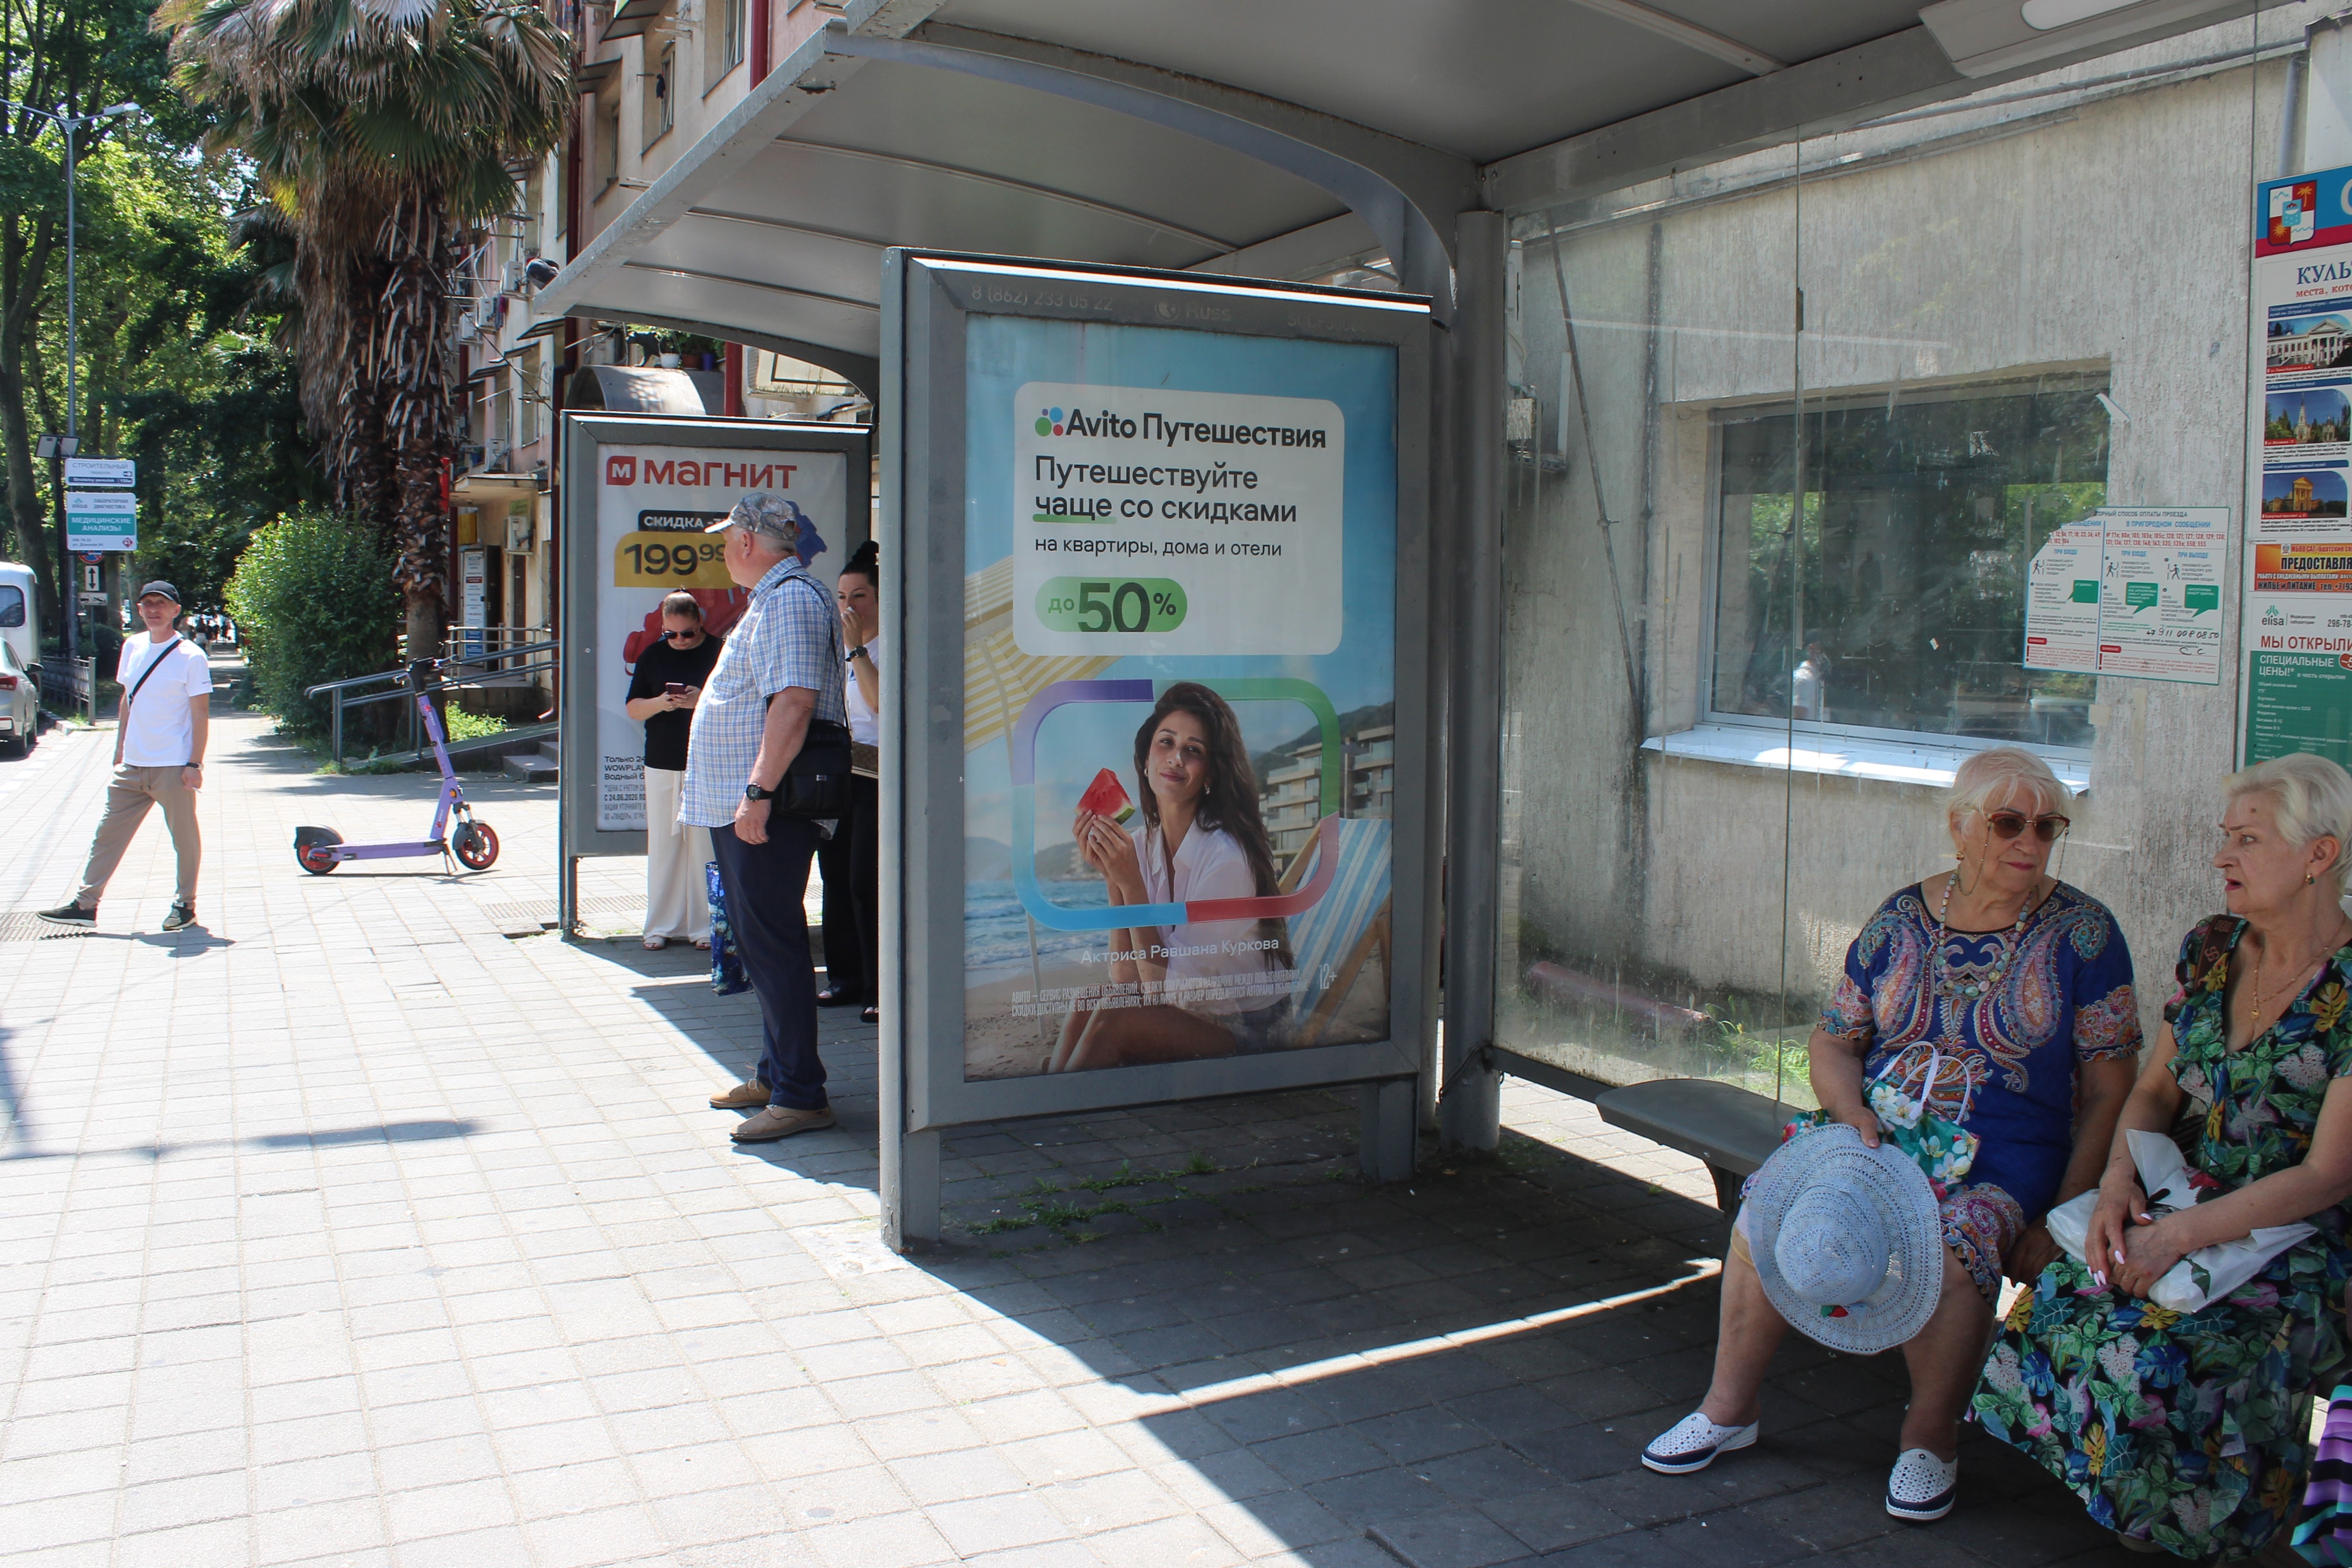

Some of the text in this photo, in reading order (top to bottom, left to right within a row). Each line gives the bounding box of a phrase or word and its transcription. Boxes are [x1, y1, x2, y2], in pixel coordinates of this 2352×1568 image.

[2297, 261, 2352, 285] КУЛЬ
[988, 285, 1028, 306] (862)
[1034, 291, 1063, 307] 233
[2296, 287, 2328, 298] места,
[1066, 409, 1326, 448] Avito Путешествия
[1035, 455, 1258, 494] Путешествуйте
[1035, 496, 1297, 525] чаще со скидками
[644, 516, 705, 530] СКИДКА
[1035, 537, 1282, 557] на квартиры, дома и отели
[2281, 557, 2352, 572] ПРЕДОСТАВЛЯ
[2258, 581, 2280, 590] ЖИЛЬЕ
[2287, 582, 2316, 590] ПИТАНИЕ
[1048, 598, 1074, 614] до
[2262, 615, 2284, 626] elisa
[2261, 635, 2283, 648] МЫ
[2260, 655, 2334, 667] СПЕЦИАЛЬНЫЕ
[1080, 939, 1279, 965] Актриса Равшана Куркова
[1318, 963, 1337, 990] 12+
[1011, 990, 1031, 1004] АВИТО
[1040, 988, 1061, 1002] СЕРВИС
[1062, 985, 1100, 1001] РАЗМЕЩЕНИЯ
[1101, 981, 1139, 997] ОБЪЯВЛЕНИЙ.
[1140, 980, 1162, 994] СДЕЛКИ
[1203, 974, 1234, 988] НАПРЯМУЮ
[1235, 972, 1254, 986] МЕЖДУ
[1011, 1003, 1036, 1018] СКИДКИ
[1037, 1001, 1067, 1016] ДОСТУПНЫ
[1068, 1000, 1076, 1012] НЕ
[1077, 999, 1085, 1012] ВО
[1086, 998, 1100, 1011] ВСЕХ
[1101, 994, 1142, 1010] ОБЪЯВЛЕНИЯХ;
[1143, 993, 1151, 1006] ИХ
[1183, 989, 1204, 1003] РАЗМЕР
[1246, 983, 1274, 997] АВТОРАМИ
